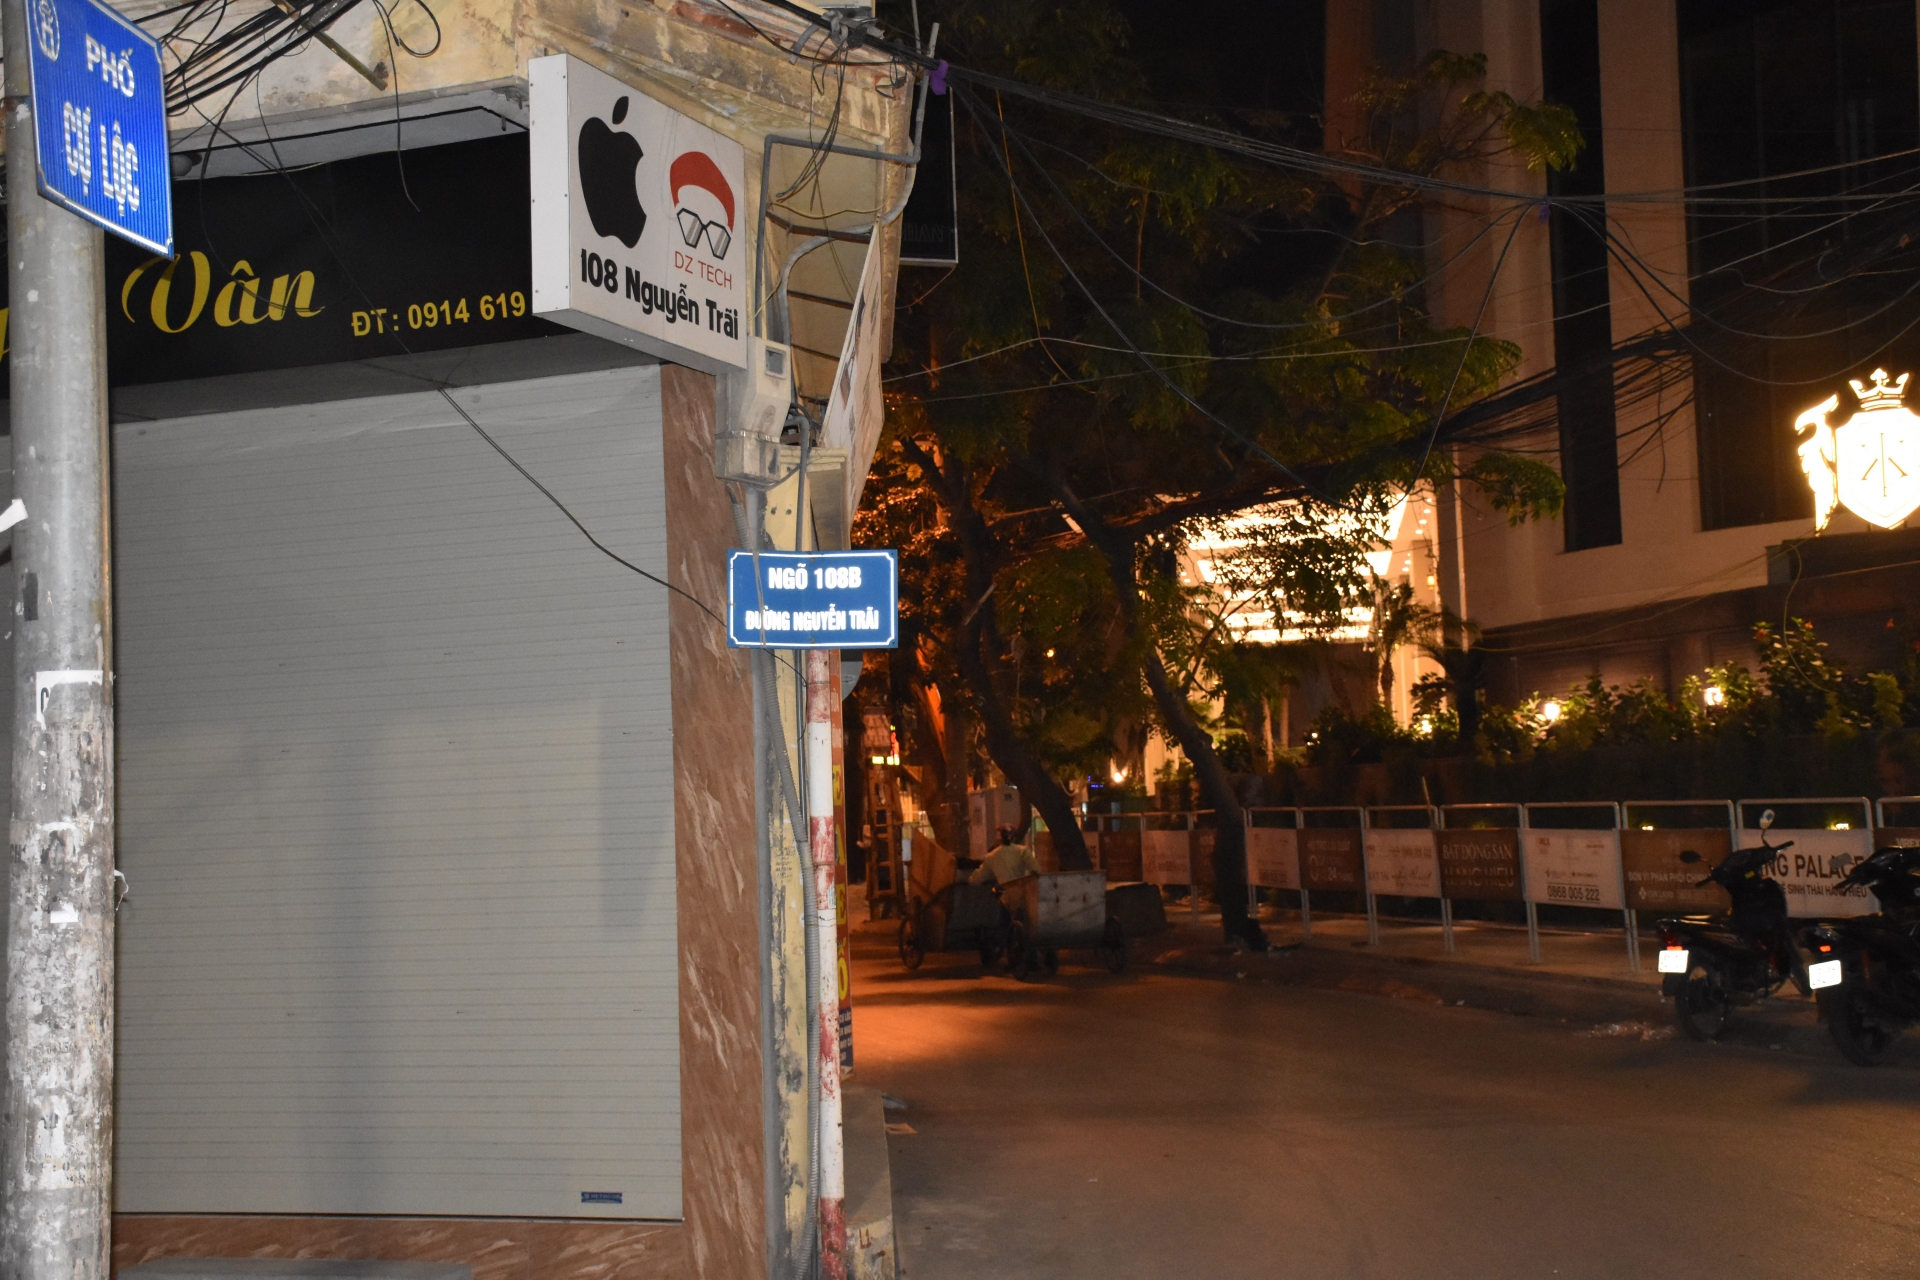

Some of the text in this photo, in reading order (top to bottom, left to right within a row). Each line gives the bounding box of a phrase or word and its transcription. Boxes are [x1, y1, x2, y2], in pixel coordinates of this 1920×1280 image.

[86, 33, 135, 98] PHỐ
[63, 101, 140, 217] CỰ LỘC
[674, 250, 733, 290] DZ TECH
[121, 251, 325, 333] Vân
[407, 298, 470, 330] 0914
[479, 291, 526, 321] 619
[580, 248, 739, 340] 108 Nguyễn Trãi
[768, 563, 862, 590] NGÕ 108B
[745, 604, 880, 631] ĐƯỜNG NGUYỄN TRÃI
[1585, 888, 1600, 902] 222
